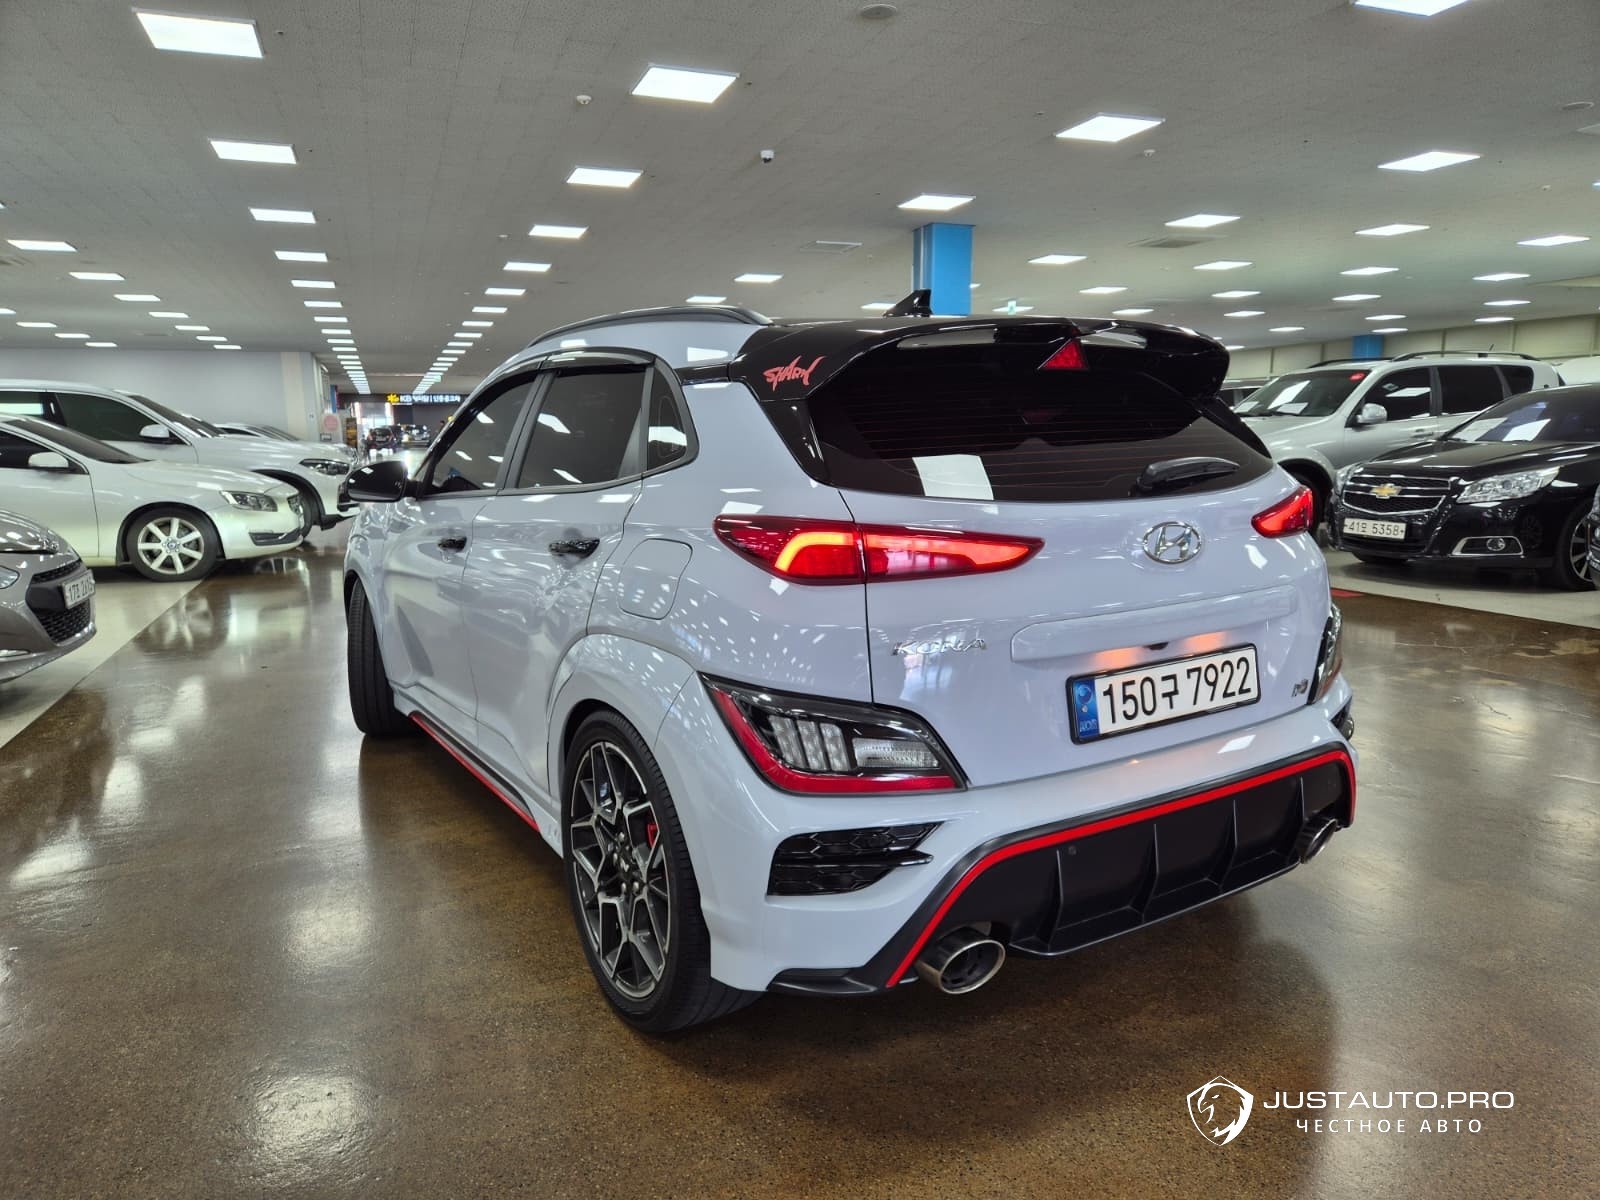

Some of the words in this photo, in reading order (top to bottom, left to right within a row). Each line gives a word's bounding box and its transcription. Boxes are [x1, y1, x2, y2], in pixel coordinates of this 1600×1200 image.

[1372, 522, 1400, 536] 5358
[1102, 673, 1179, 725] 150구
[1186, 656, 1252, 706] 7922
